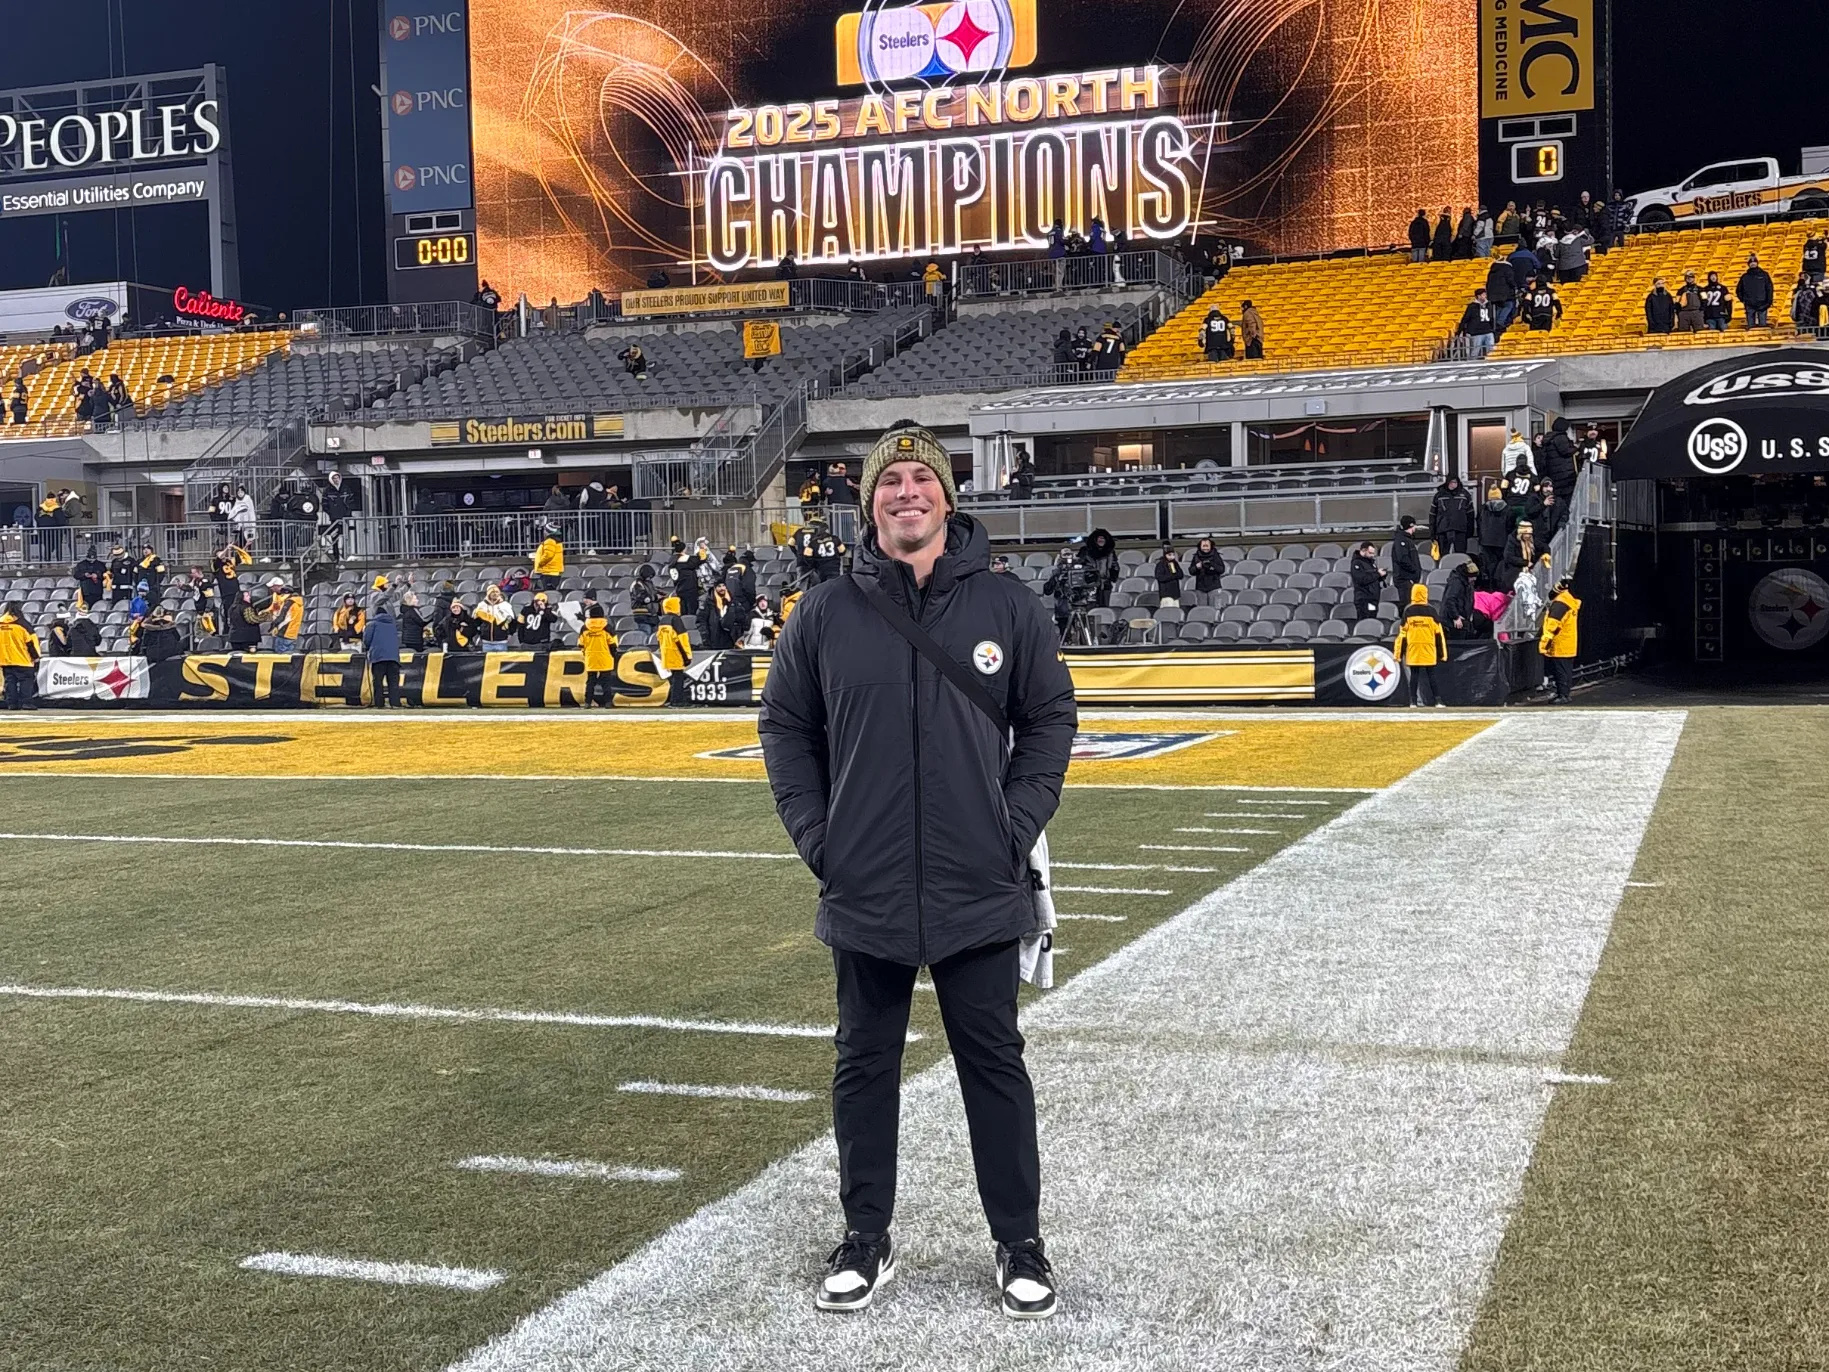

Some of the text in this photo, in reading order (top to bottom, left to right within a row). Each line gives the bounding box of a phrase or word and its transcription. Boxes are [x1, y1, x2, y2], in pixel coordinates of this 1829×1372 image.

[414, 12, 462, 36] PNC
[879, 31, 930, 51] Steelers
[1495, 17, 1508, 101] MEDICINE
[415, 88, 464, 112] PNC
[727, 64, 1160, 149] 2025 AFC NORTH
[1539, 146, 1558, 176] 0
[418, 163, 467, 187] PNC
[3, 180, 205, 211] Essential Utilities Company
[704, 115, 1193, 272] CHAMPIONS
[1693, 190, 1762, 215] Steelers
[417, 236, 468, 265] 0:00
[174, 286, 244, 321] Caliente
[625, 288, 786, 310] OUR STEELERS PROUDLY SUPPORT UNITED WAY
[1534, 293, 1551, 308] 90
[1210, 320, 1226, 332] 90
[1106, 339, 1115, 354] 7
[1709, 371, 1829, 396] USS
[465, 417, 587, 444] Steelers.com
[1696, 432, 1739, 461] USS
[1511, 477, 1530, 495] 30
[218, 501, 232, 515] 90
[818, 541, 835, 557] 43
[526, 614, 542, 630] 90
[52, 672, 89, 686] Steelers
[689, 683, 727, 701] 1933
